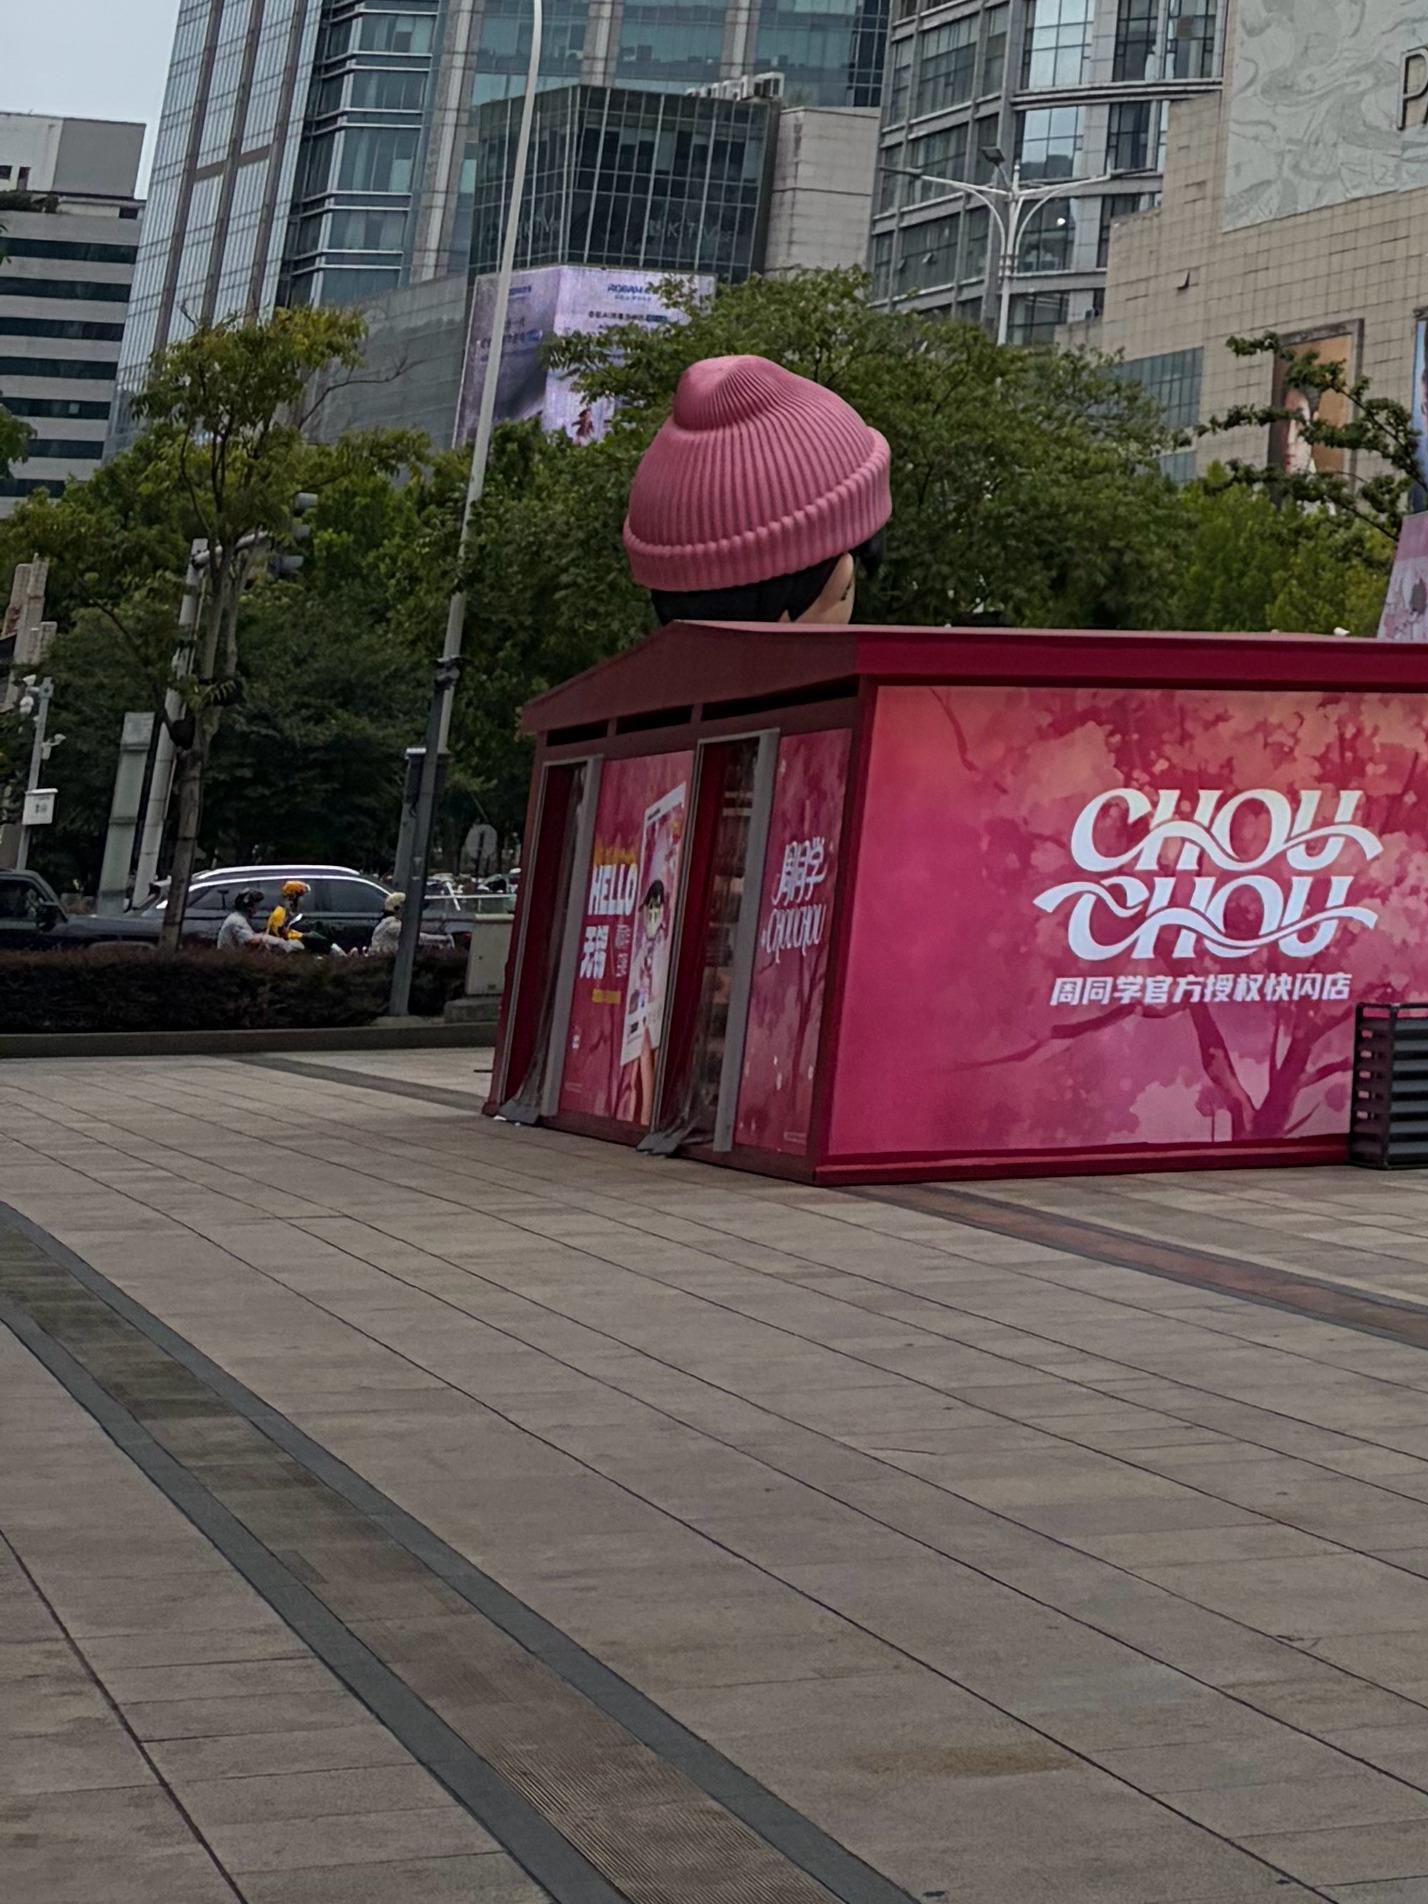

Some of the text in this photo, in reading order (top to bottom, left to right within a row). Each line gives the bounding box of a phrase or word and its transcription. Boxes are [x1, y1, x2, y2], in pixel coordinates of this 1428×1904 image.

[1070, 788, 1384, 871] CHOU
[588, 863, 638, 915] HELLO
[1033, 875, 1377, 960] CHOU
[1050, 972, 1353, 1007] 周同学官方授权快闪店
